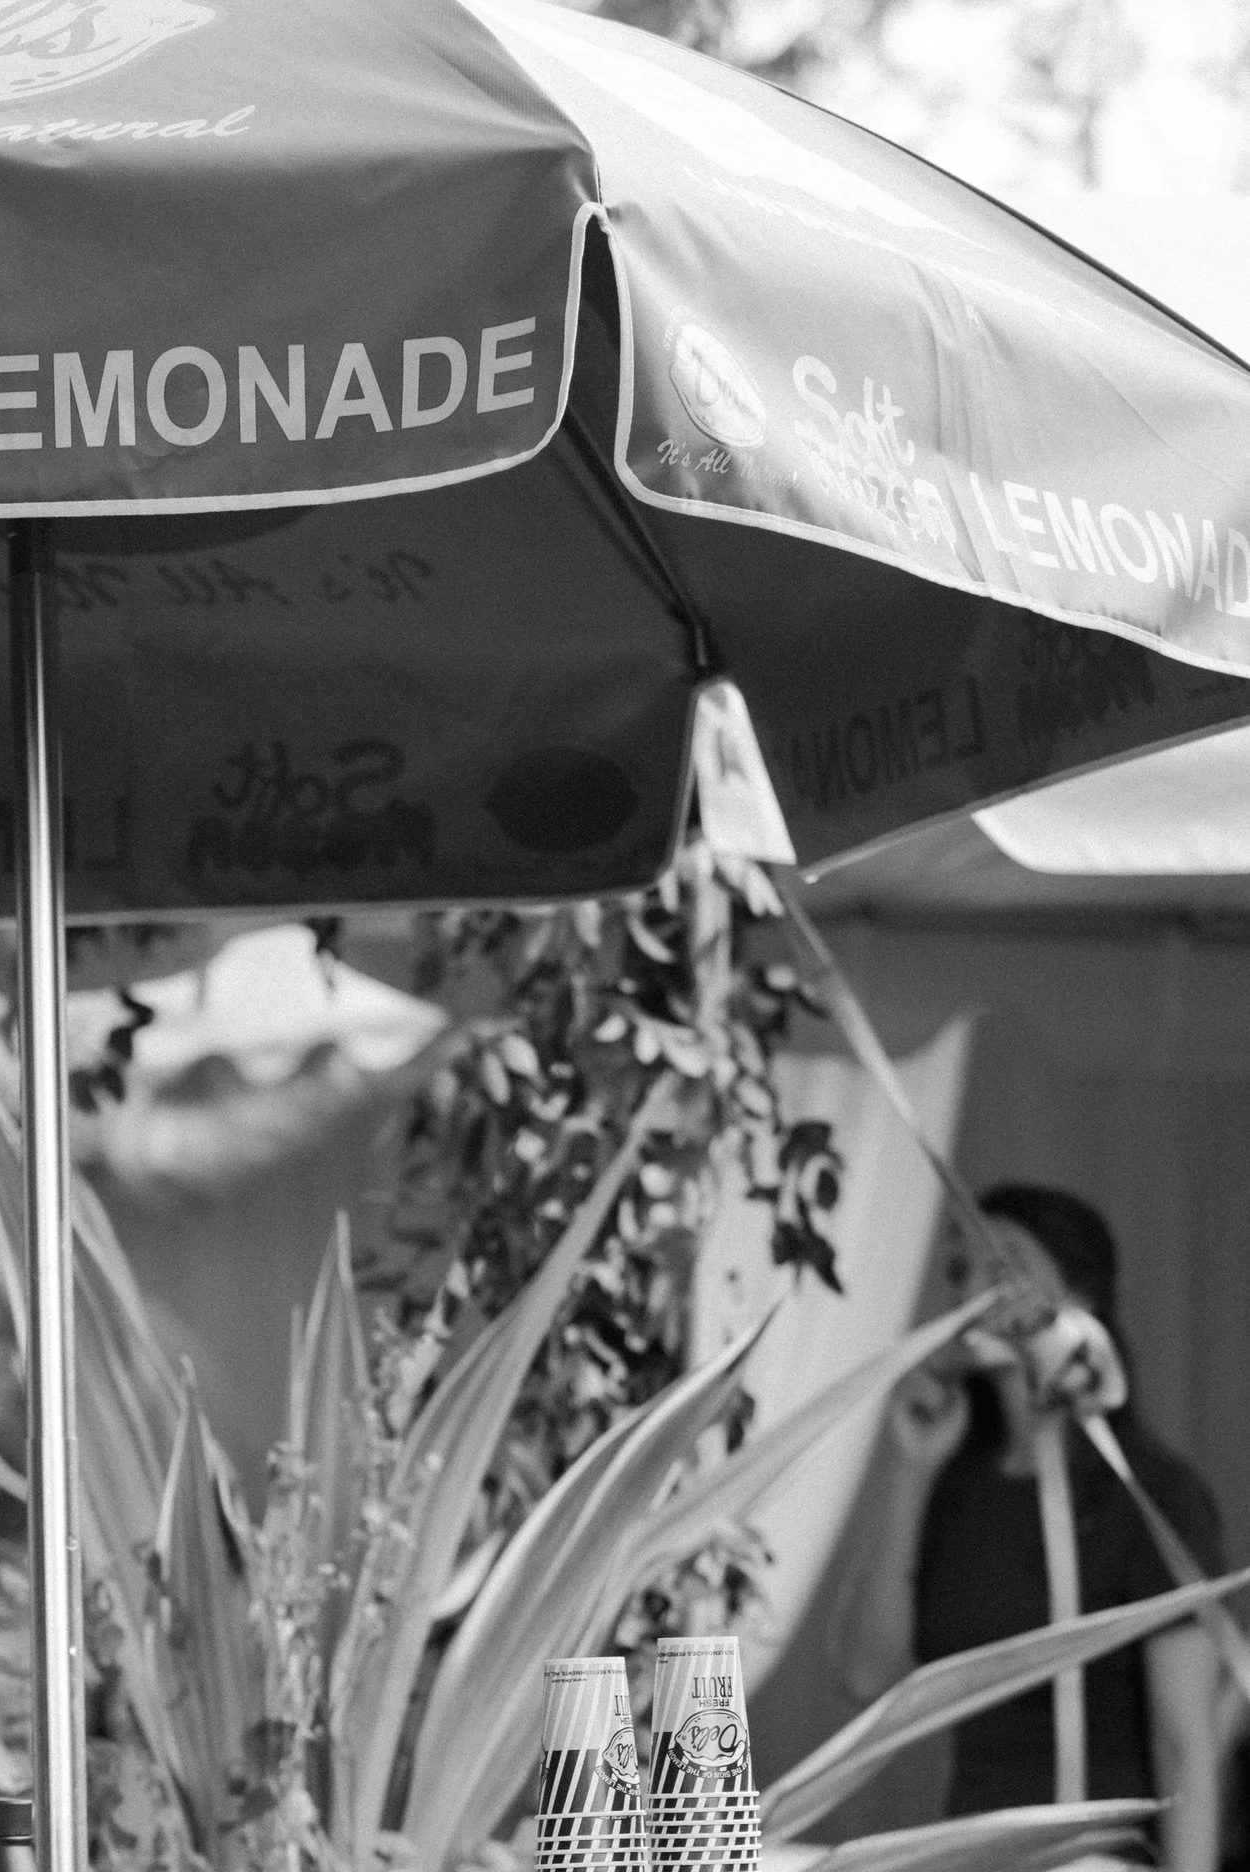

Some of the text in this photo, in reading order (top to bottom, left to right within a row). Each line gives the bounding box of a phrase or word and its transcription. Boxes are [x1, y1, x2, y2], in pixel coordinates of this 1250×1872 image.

[657, 438, 691, 468] It's
[695, 448, 730, 475] All
[692, 1676, 734, 1699] FRUIT
[699, 1699, 730, 1707] FRESH
[667, 1749, 687, 1770] LEMON
[595, 1766, 616, 1787] LEMON
[686, 1766, 701, 1777] THE
[714, 1770, 731, 1778] SIGN
[730, 1765, 743, 1777] THE
[615, 1783, 627, 1793] THE
